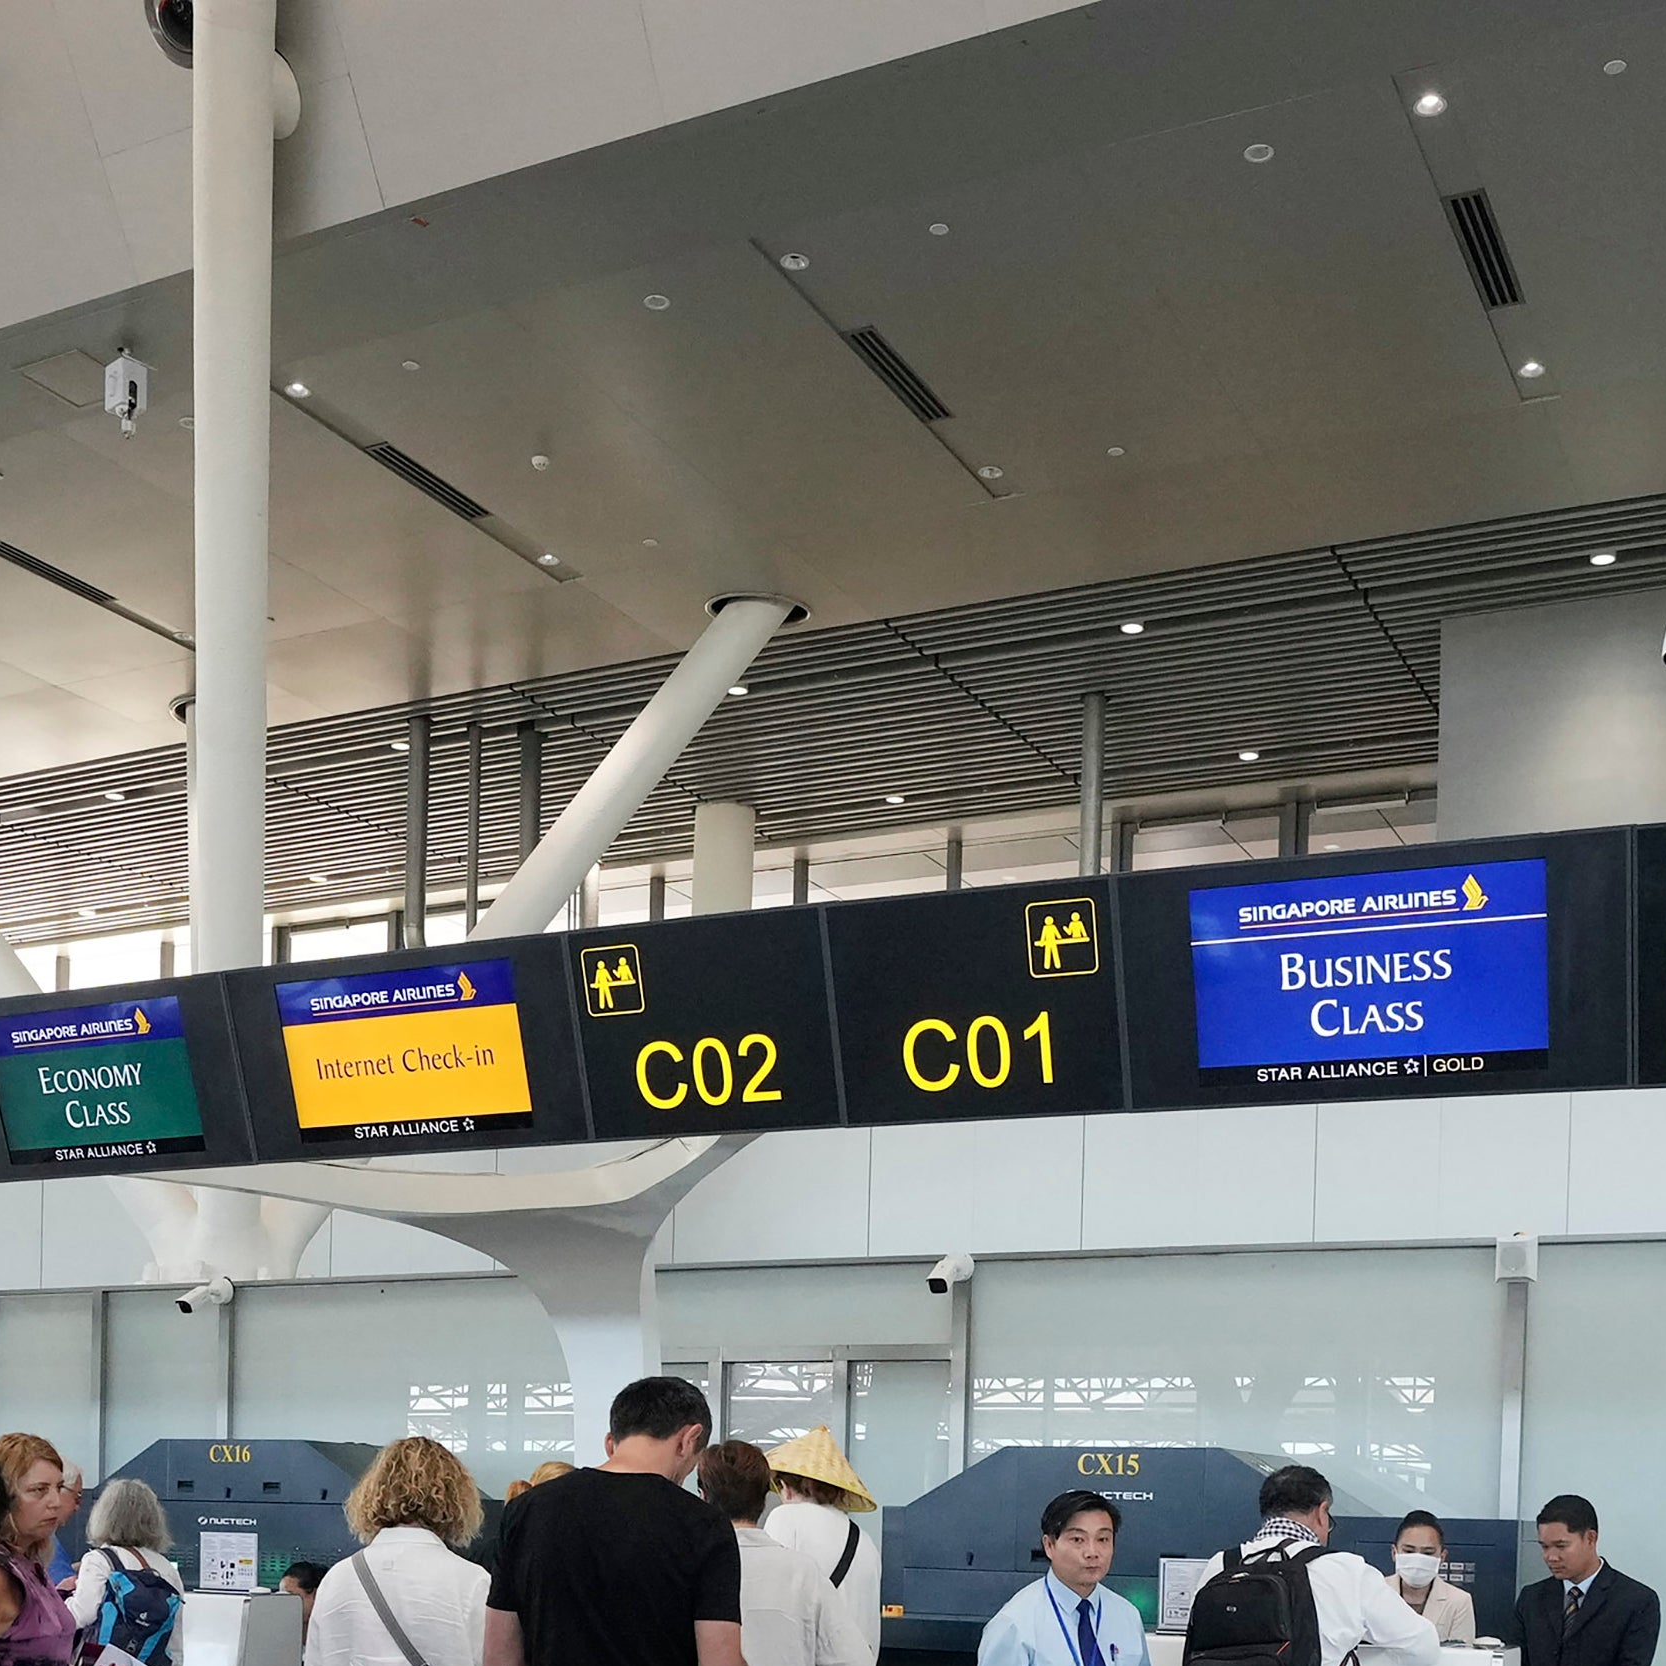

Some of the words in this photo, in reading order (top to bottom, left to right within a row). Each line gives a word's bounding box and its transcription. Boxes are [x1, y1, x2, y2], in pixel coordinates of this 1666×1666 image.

[1238, 897, 1356, 924] SINGAPORE
[1361, 889, 1457, 914] AIRLINES
[1280, 949, 1452, 991] BUSINESS
[310, 990, 389, 1012] SINGAPORE
[392, 983, 455, 1004] AIRLINES
[11, 1024, 78, 1046] SINGAPORE
[80, 1018, 134, 1038] AIRLINES
[1310, 999, 1424, 1037] CLASS
[315, 1046, 396, 1081] Internet
[401, 1044, 496, 1076] Check-in
[903, 1011, 1055, 1092] C01
[37, 1063, 142, 1095] ECONOMY
[635, 1033, 782, 1110] C02
[1257, 1066, 1302, 1082] STAR
[1307, 1061, 1398, 1079] ALLIANCE
[1432, 1056, 1485, 1073] GOLD
[65, 1100, 131, 1129] CLASS
[353, 1124, 391, 1140] STAR
[393, 1119, 460, 1137] ALLIANCE
[54, 1148, 85, 1161] STAR
[87, 1143, 144, 1159] ALLIANCE
[209, 1445, 251, 1462] CX16
[1077, 1453, 1140, 1476] CX15
[1093, 1491, 1153, 1501] CTECH
[209, 1517, 257, 1526] NUCTECH
